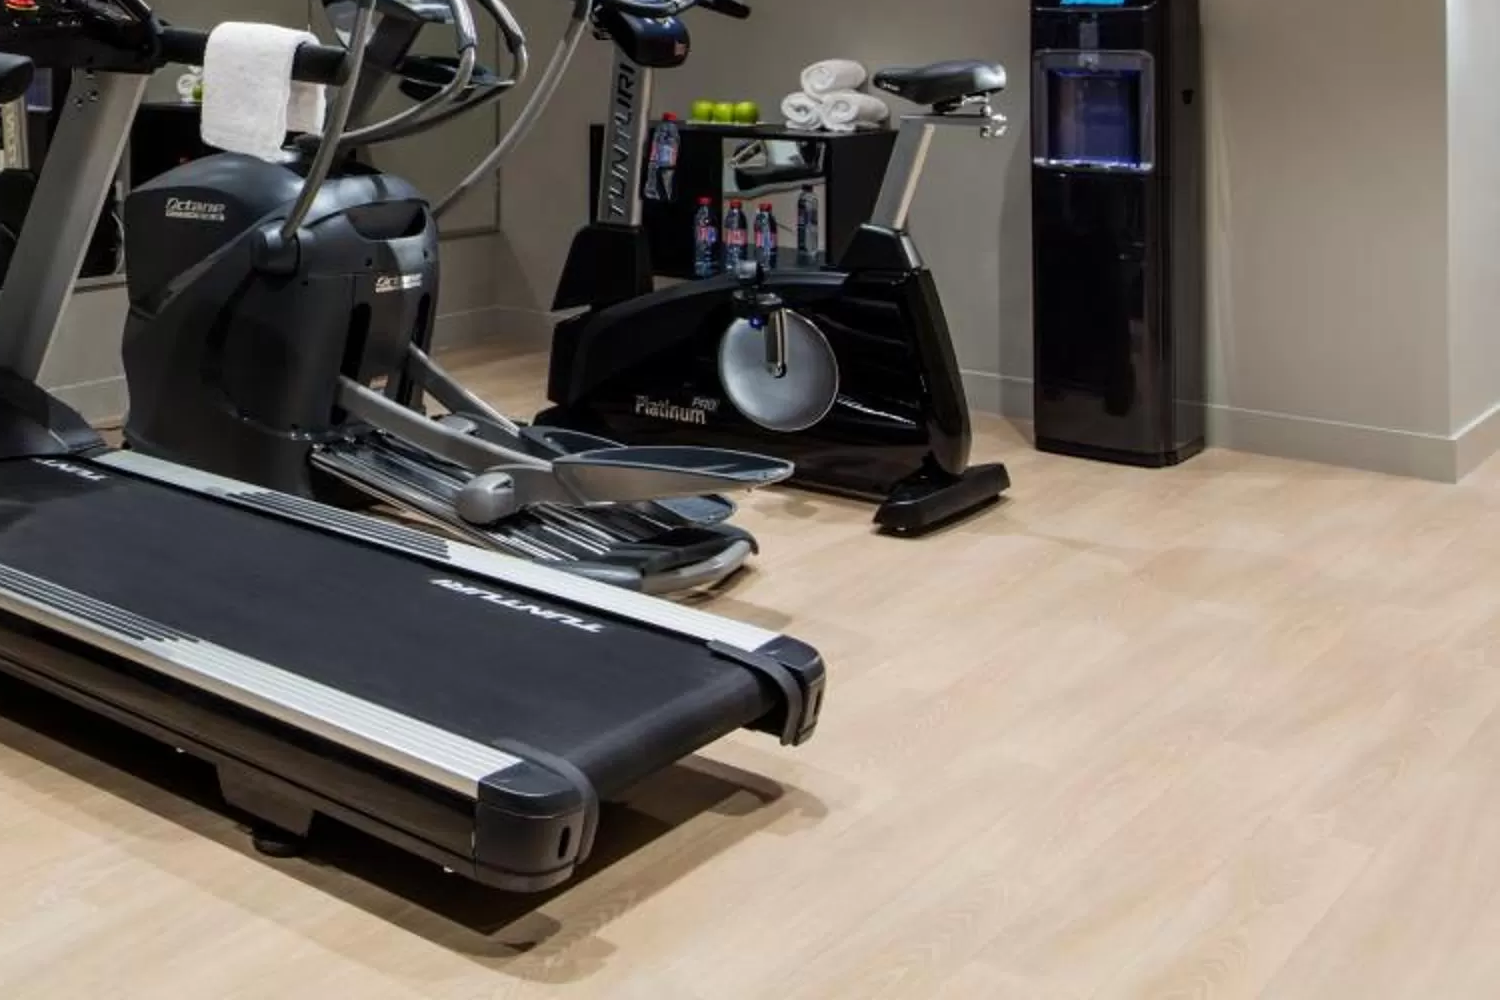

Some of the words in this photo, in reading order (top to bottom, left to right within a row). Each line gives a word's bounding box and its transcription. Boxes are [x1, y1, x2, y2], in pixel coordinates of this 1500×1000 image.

[608, 62, 636, 216] TUNTURI
[635, 394, 706, 425] Platinum
[429, 577, 605, 633] TUNTURI
